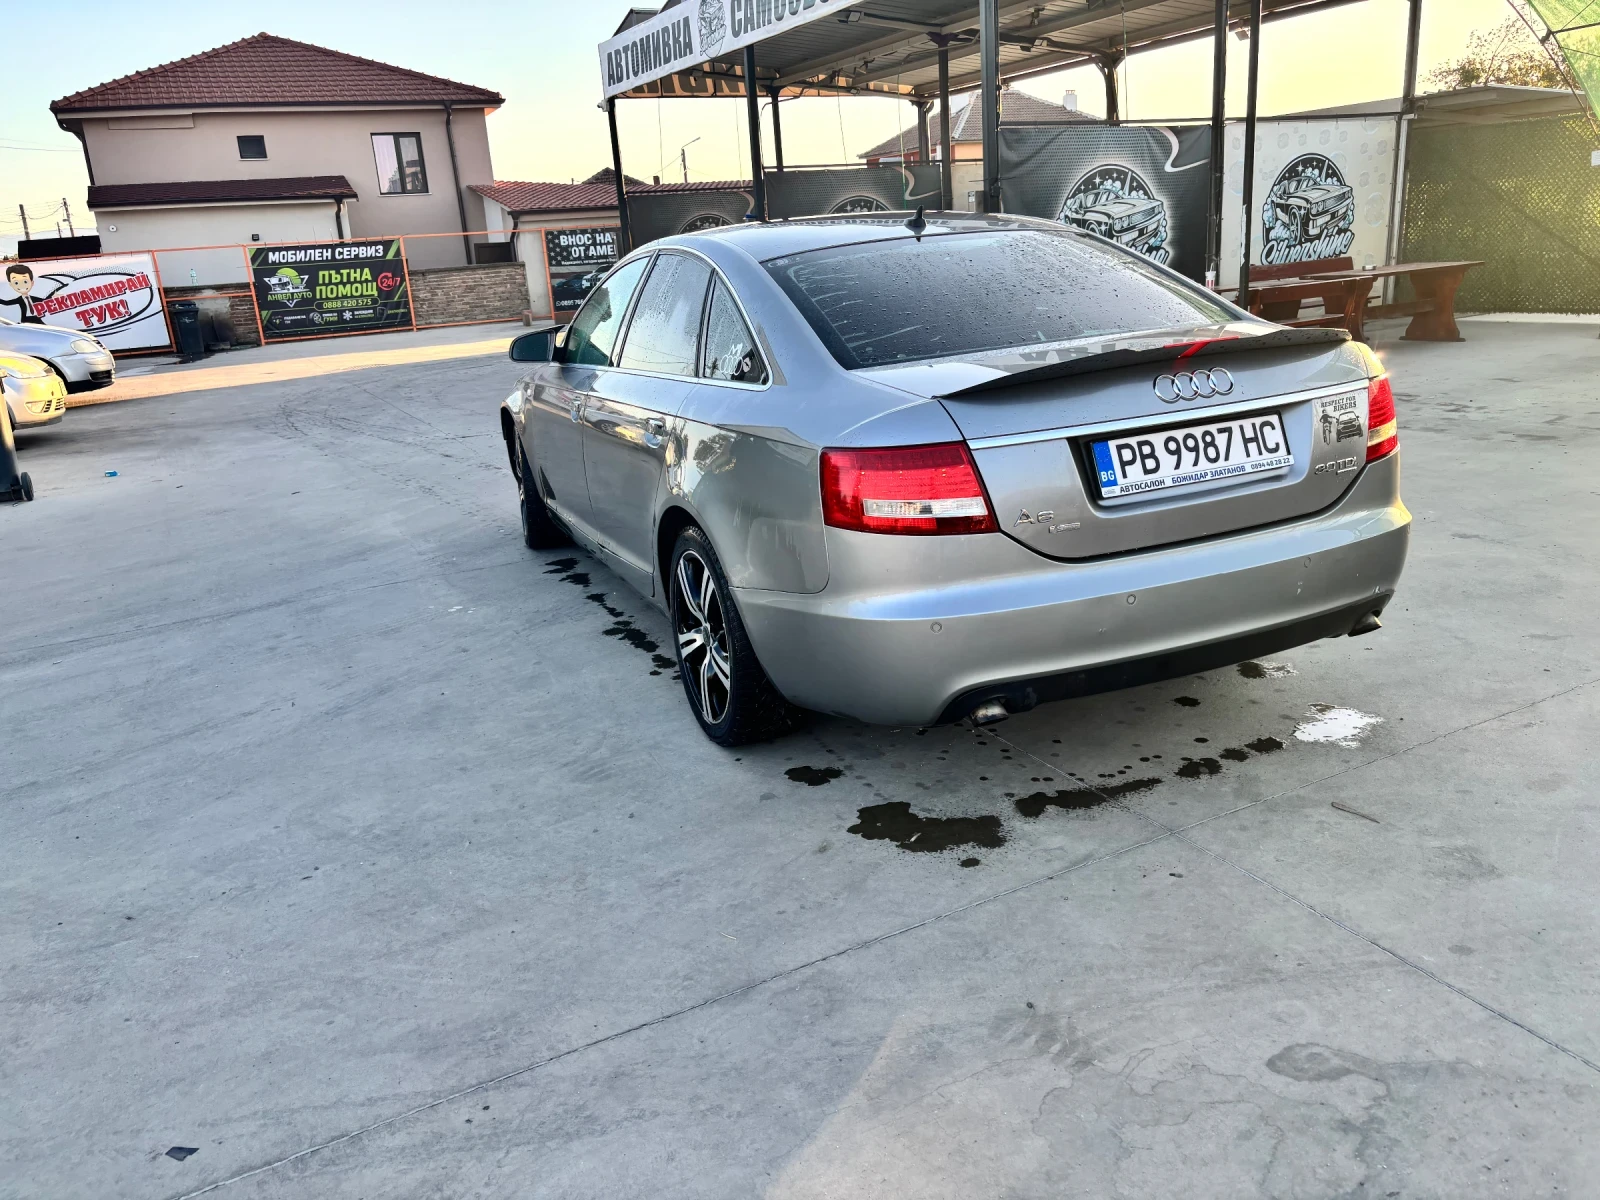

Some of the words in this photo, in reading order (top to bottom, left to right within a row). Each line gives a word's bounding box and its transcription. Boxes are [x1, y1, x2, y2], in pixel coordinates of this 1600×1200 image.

[607, 15, 694, 87] АВТОМИВКА
[559, 233, 593, 246] ВНОС
[595, 232, 613, 244] НА
[268, 248, 332, 264] МОБИЛЕН
[334, 245, 384, 259] СЕРВИЗ
[571, 246, 586, 258] ОТ
[318, 267, 372, 285] ПЪТНА
[382, 277, 401, 287] 24/7
[33, 271, 151, 318] РЕКЛАМИРАЙ
[293, 291, 313, 300] АУТО
[315, 281, 378, 300] ПОМОЩ
[322, 300, 342, 309] 0888
[342, 299, 357, 307] 420
[357, 298, 372, 306] 575
[75, 298, 132, 328] ТУК!
[1320, 397, 1345, 409] RESPECT
[1345, 395, 1356, 403] FOR
[1333, 400, 1357, 412] BIKERS
[1163, 426, 1233, 471] 9987
[1100, 470, 1115, 482] BG
[1119, 478, 1166, 494] АВТОСАЛОН
[1171, 472, 1209, 485] БОЖИДАР
[1209, 465, 1246, 479] ЗЛАТАНОВ
[1013, 508, 1055, 527] A6
